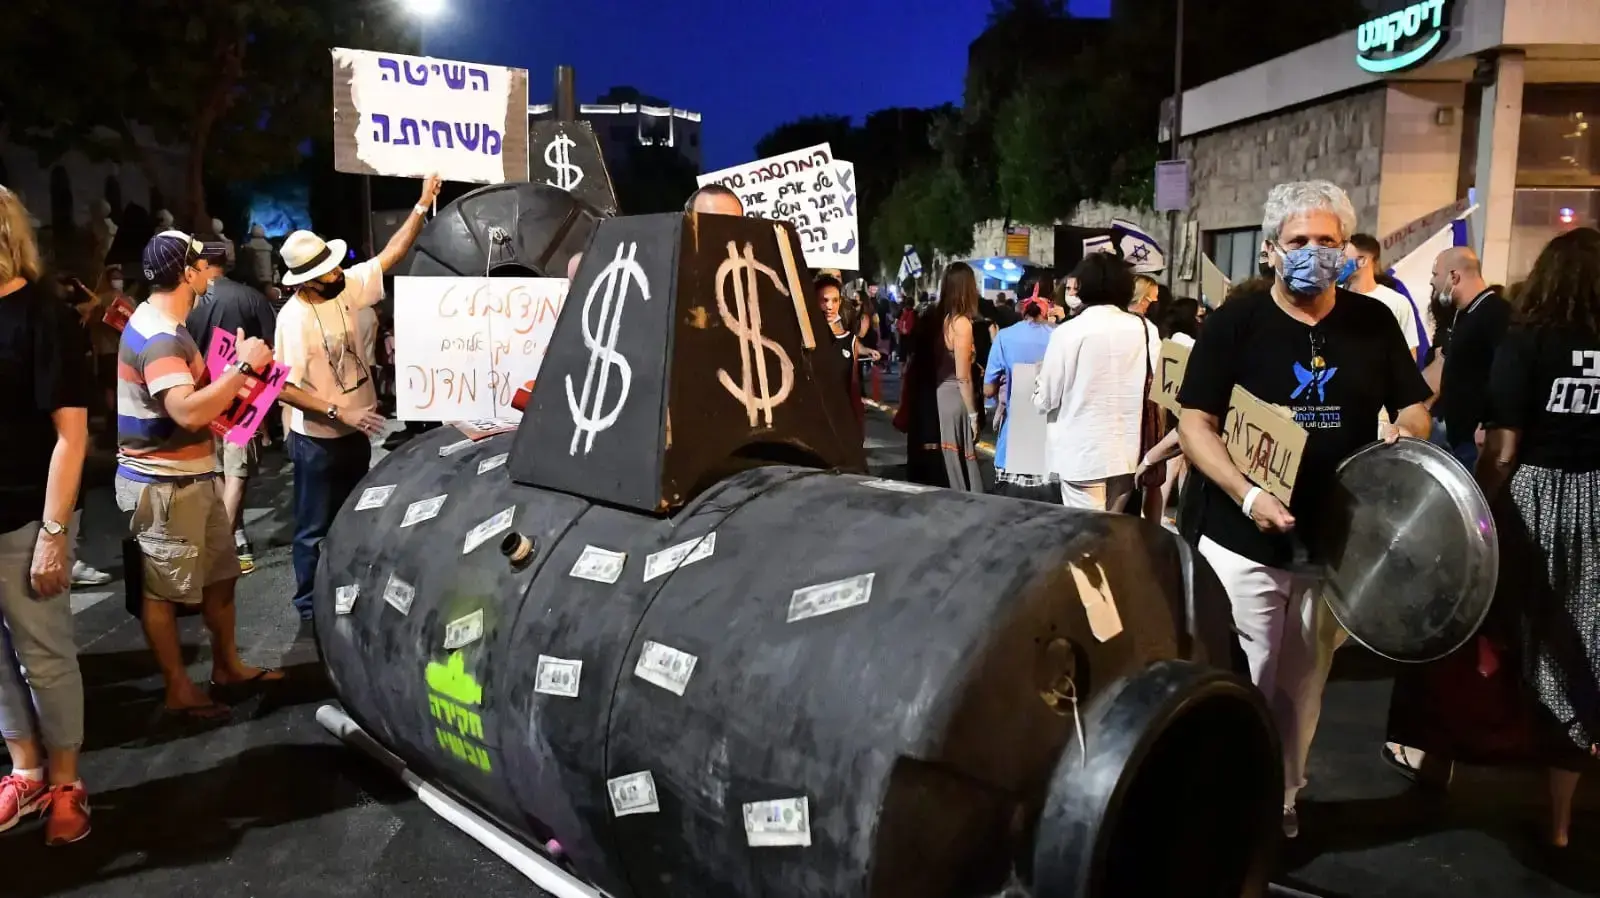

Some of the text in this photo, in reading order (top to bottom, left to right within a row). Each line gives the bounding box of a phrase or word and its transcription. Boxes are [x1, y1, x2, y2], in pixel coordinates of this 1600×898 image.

[378, 58, 489, 91] השיטה
[372, 113, 502, 155] משחיתה
[748, 150, 830, 185] המחשבה
[778, 181, 806, 199] אדם
[812, 171, 833, 192] של
[771, 199, 801, 219] משל
[819, 206, 844, 223] היא
[441, 332, 483, 351] אלוהים
[407, 365, 476, 409] מדינה
[428, 694, 484, 740] חקירה
